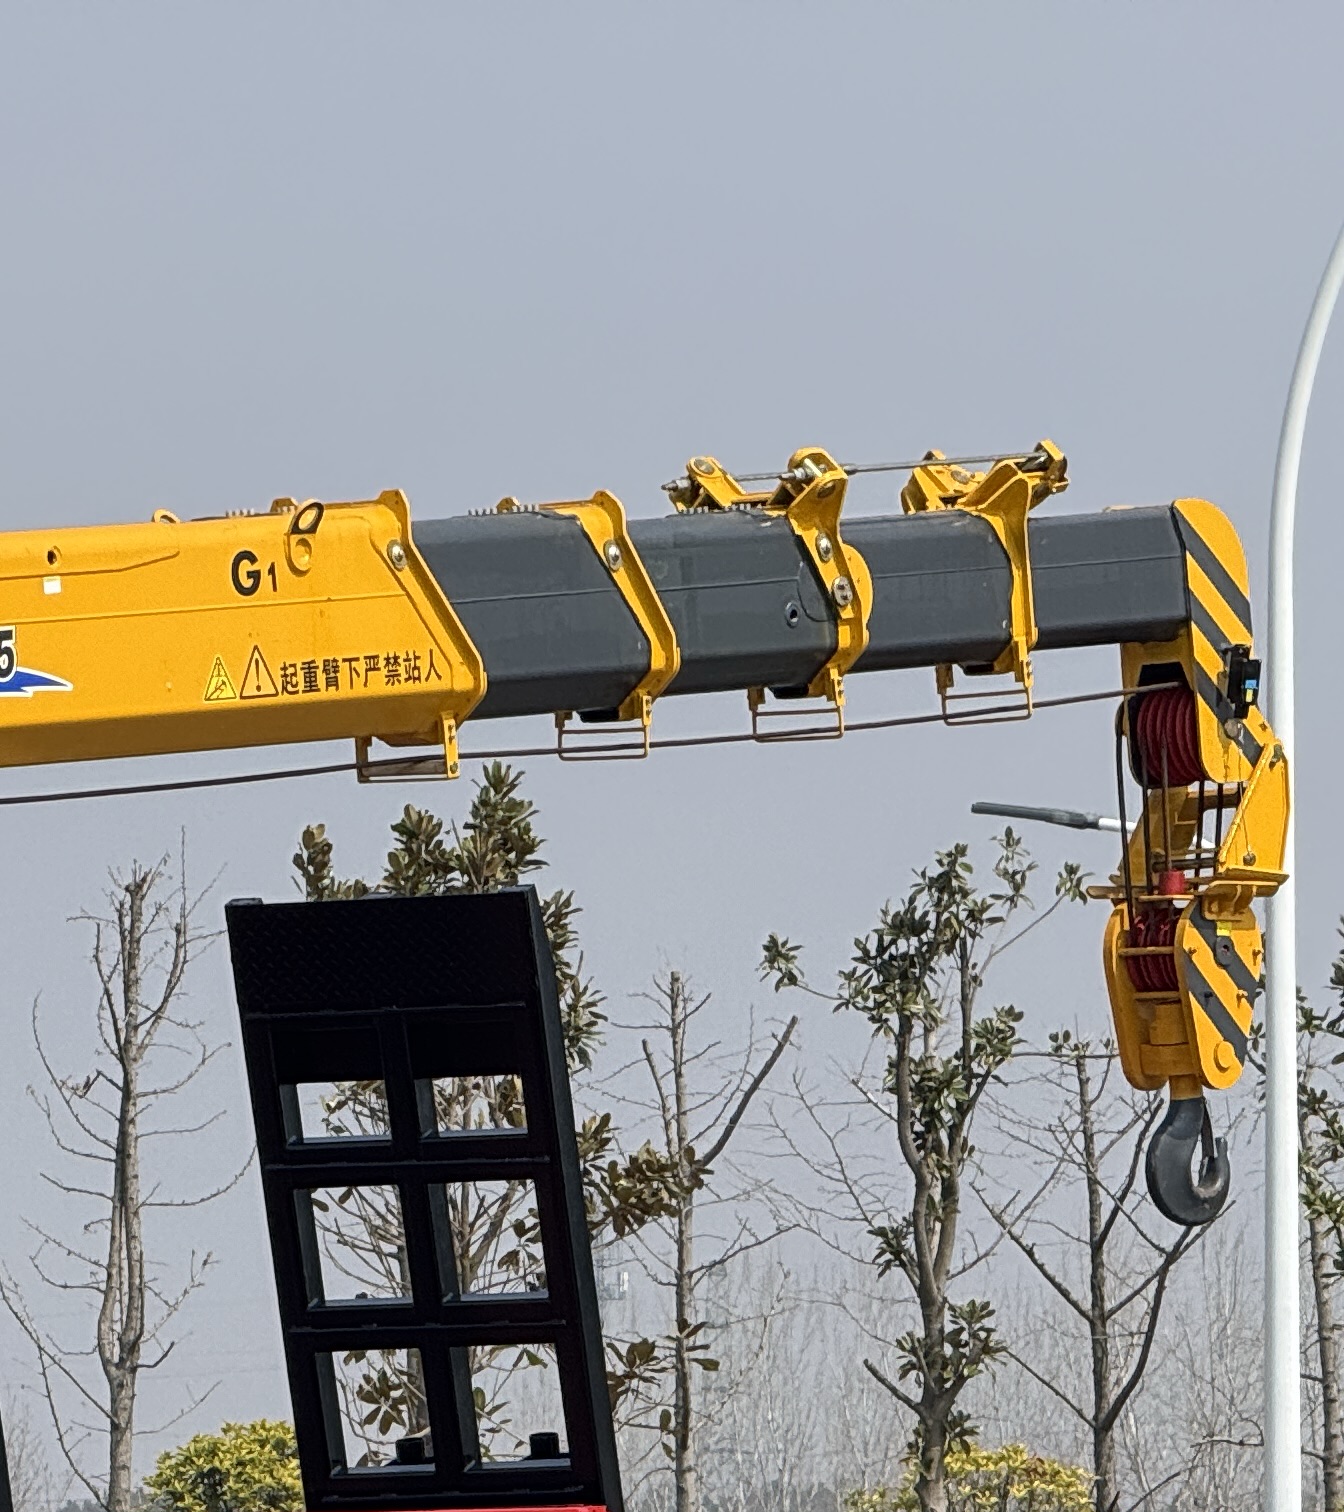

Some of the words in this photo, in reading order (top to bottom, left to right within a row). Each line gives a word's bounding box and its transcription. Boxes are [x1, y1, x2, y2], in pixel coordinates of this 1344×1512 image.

[231, 549, 278, 597] G1
[279, 648, 443, 696] 起重臂下严禁站人
